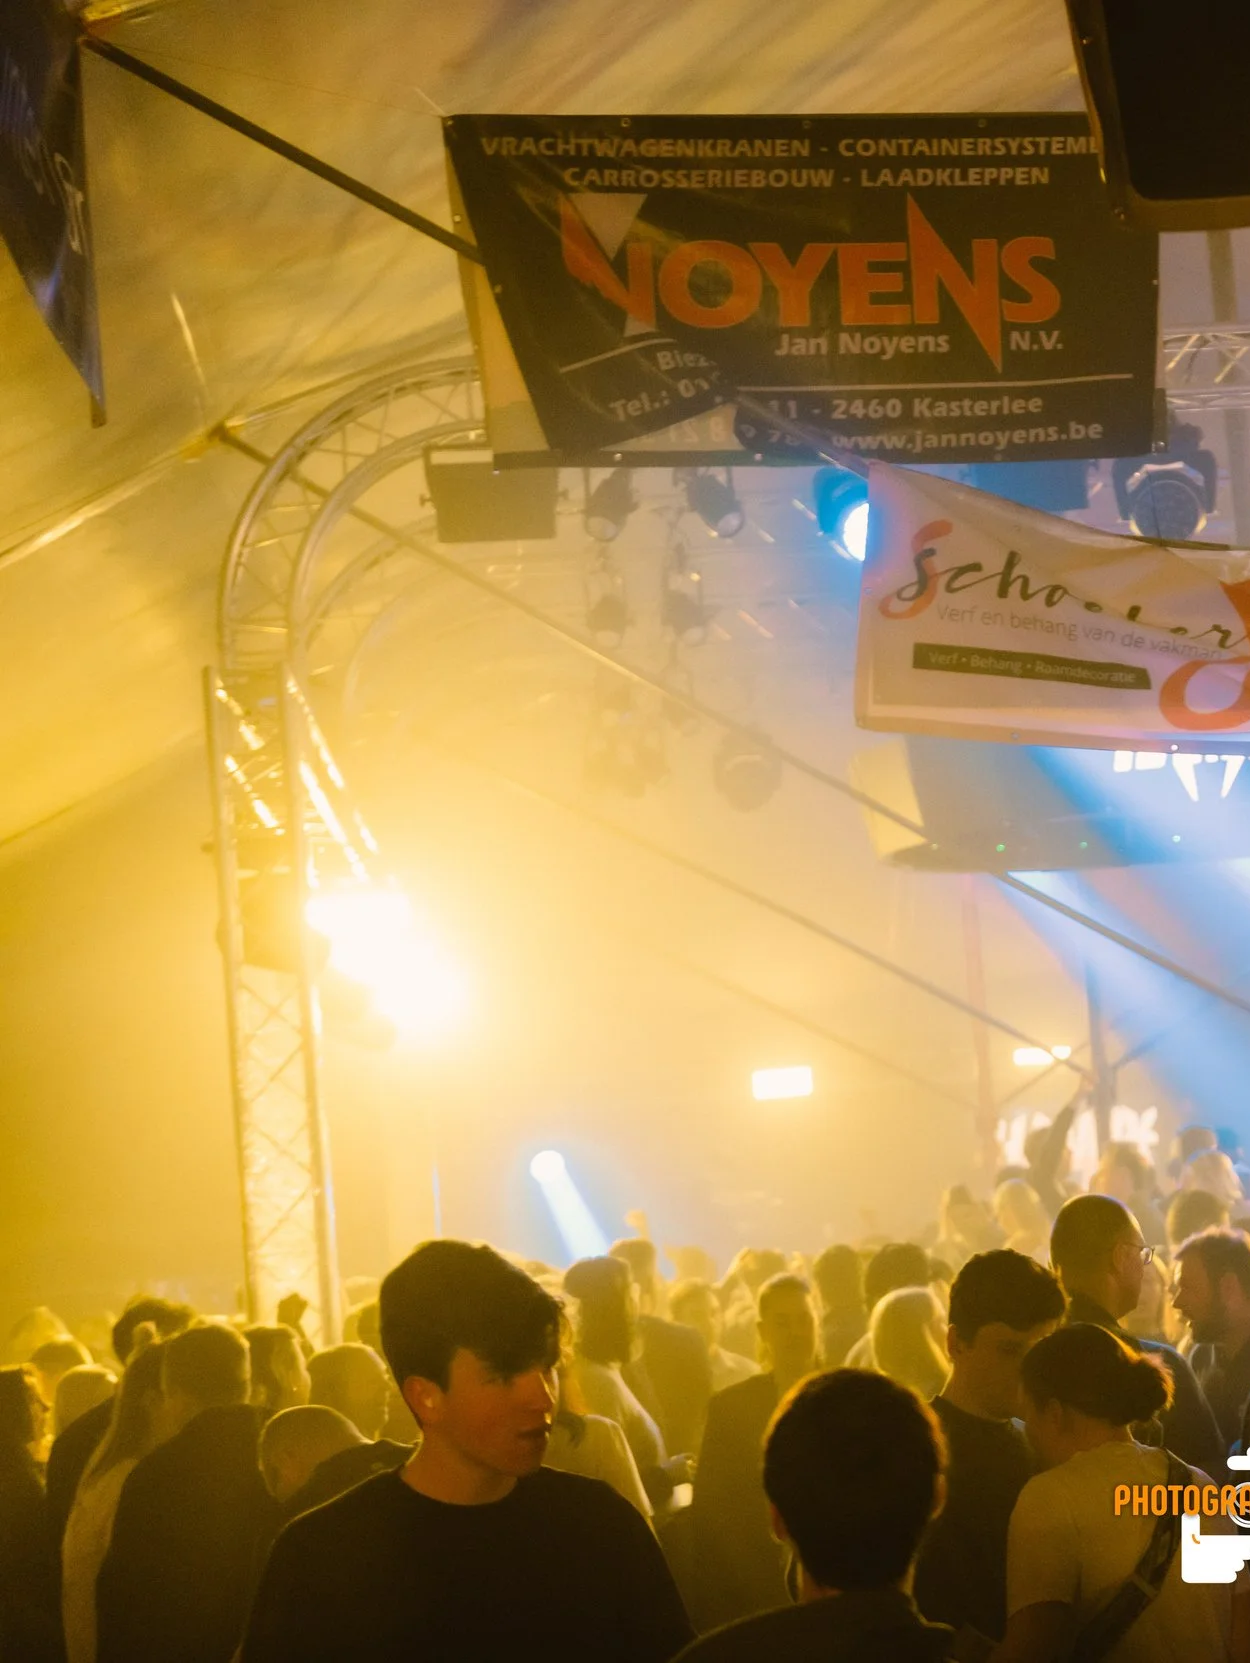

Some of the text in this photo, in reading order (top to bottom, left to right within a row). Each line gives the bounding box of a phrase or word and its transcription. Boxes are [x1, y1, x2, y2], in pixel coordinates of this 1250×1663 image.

[481, 136, 811, 158] VRACHTWAGENKRANEN
[563, 167, 835, 188] CARROSSERIEBOUW
[860, 167, 1050, 188] LAADKLEPPEN
[560, 192, 1062, 373] NOYENS
[774, 331, 951, 360] Jan Noyens
[1009, 329, 1064, 352] N.V.
[831, 398, 904, 420] 2460
[912, 394, 1043, 419] Kasterlee
[831, 420, 1104, 452] www.jannoyens.be
[936, 603, 978, 622] Verf
[981, 610, 1005, 627] en
[1010, 613, 1078, 642] behang
[1082, 626, 1117, 644] van
[1120, 629, 1147, 650] de
[929, 651, 958, 666] Verf
[970, 654, 1022, 674] Behang
